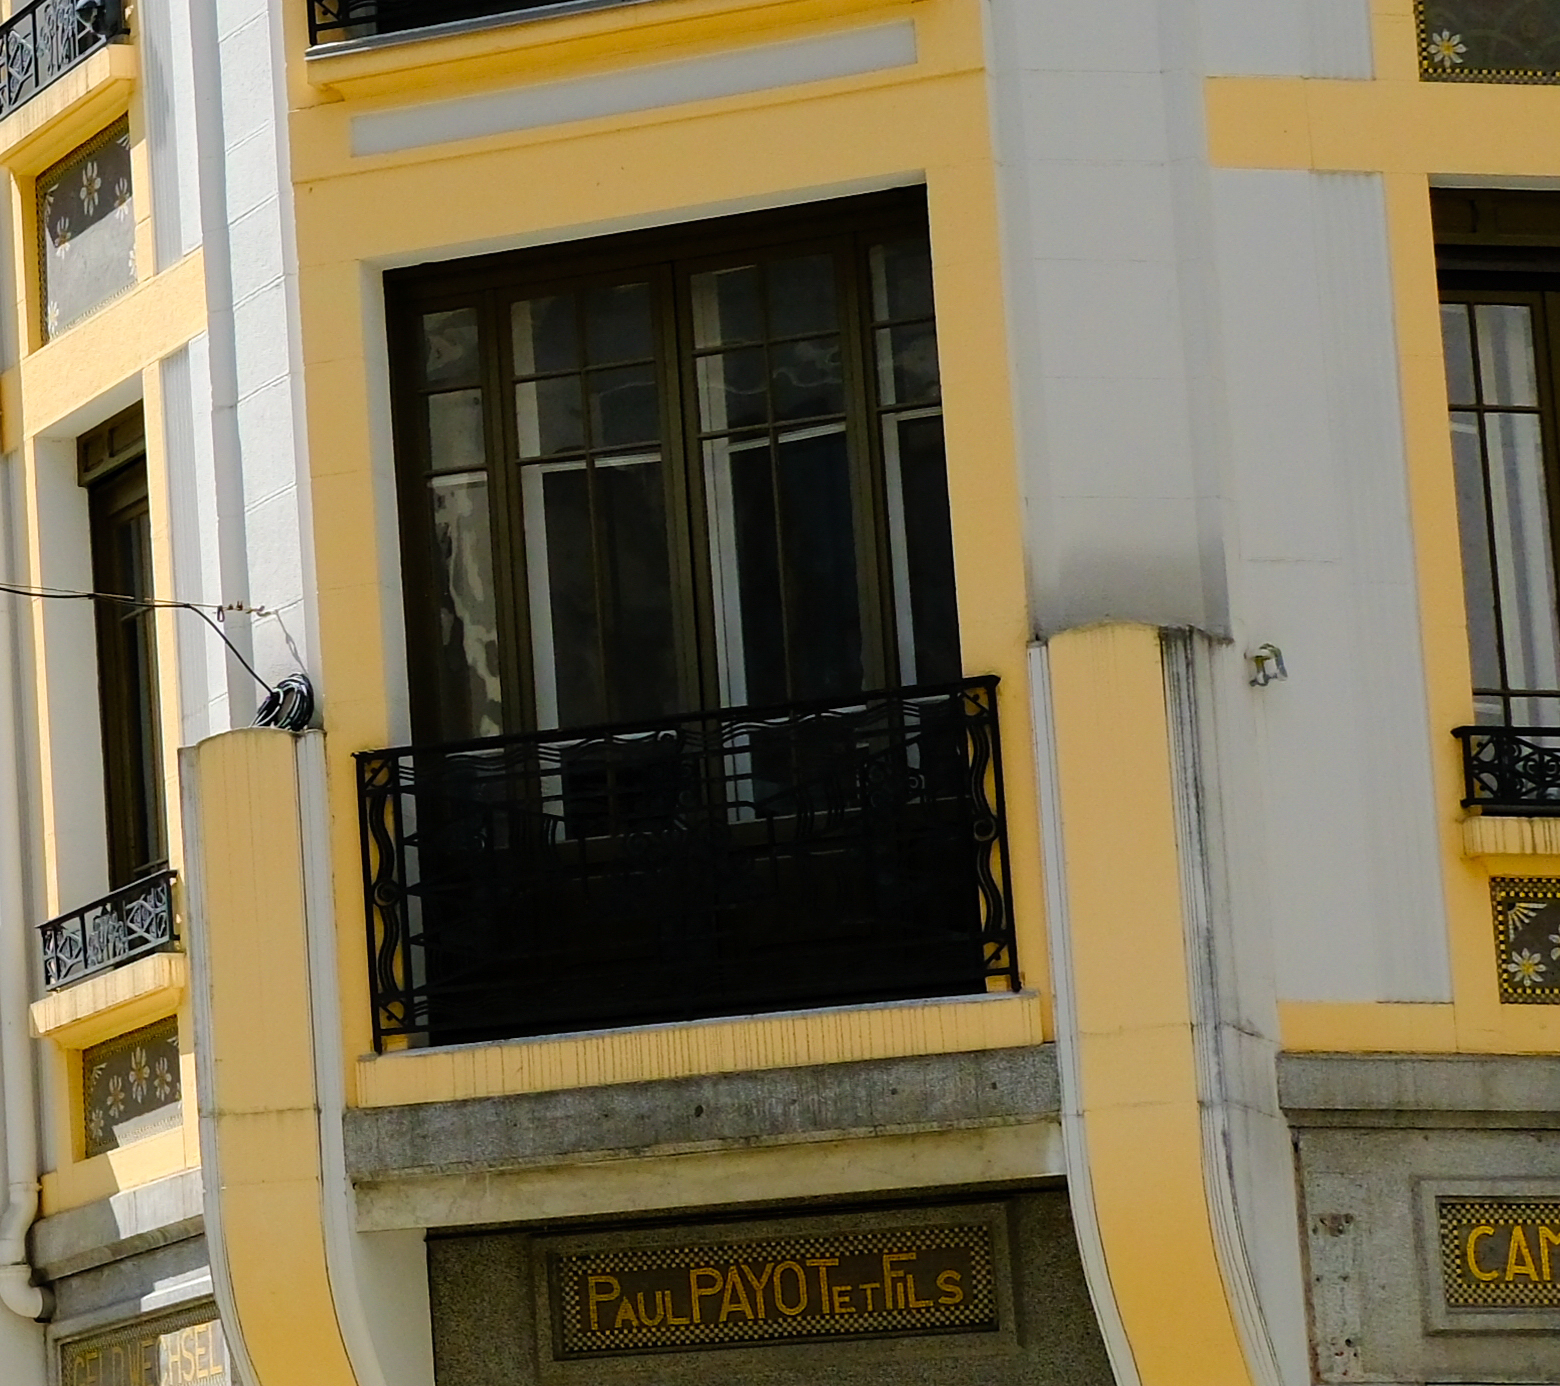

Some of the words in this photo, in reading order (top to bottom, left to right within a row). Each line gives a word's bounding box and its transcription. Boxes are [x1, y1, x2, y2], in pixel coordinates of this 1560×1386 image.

[587, 1274, 690, 1331] PAUL
[689, 1257, 839, 1324] PAYOT
[831, 1282, 881, 1314] ET
[881, 1251, 965, 1312] FILS
